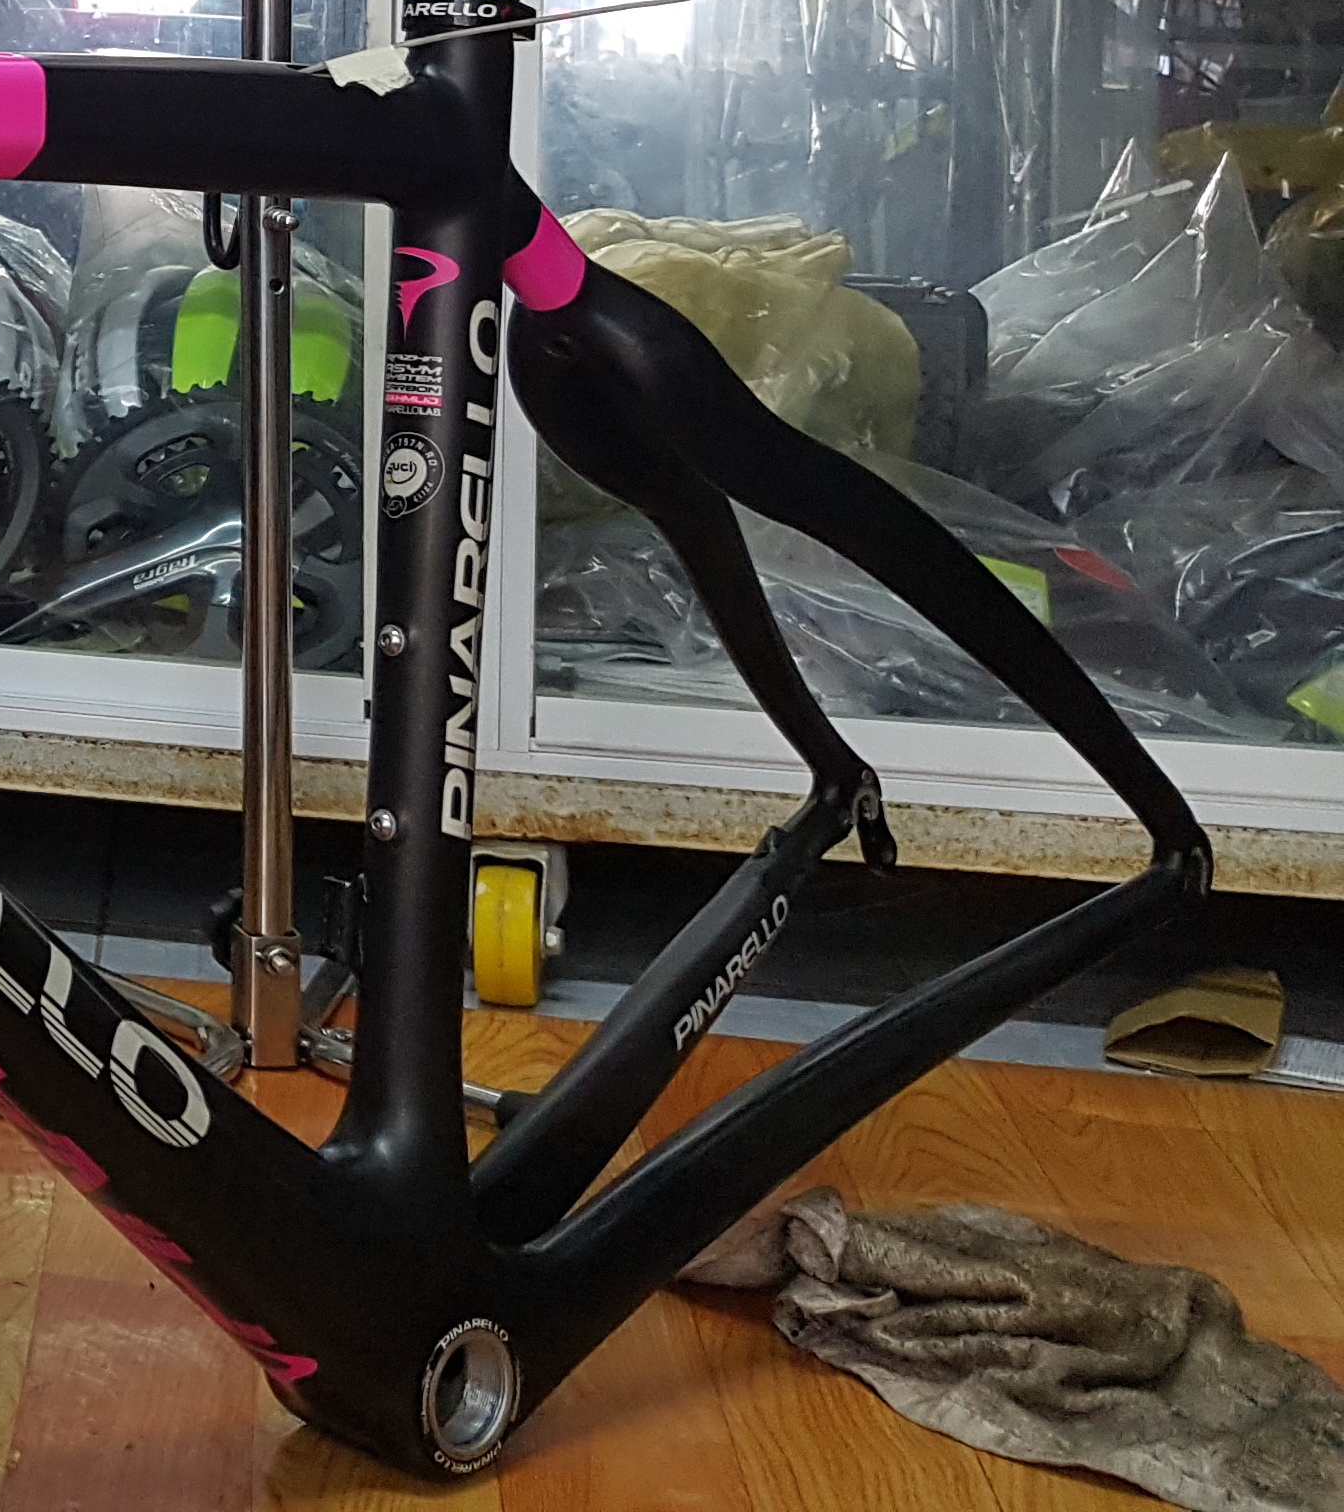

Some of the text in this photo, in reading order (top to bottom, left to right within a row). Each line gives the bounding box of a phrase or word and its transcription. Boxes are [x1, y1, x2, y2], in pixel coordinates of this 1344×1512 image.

[132, 554, 197, 586] Tiagra
[440, 299, 502, 842] PINARELLO
[672, 893, 790, 1052] PINARELLO
[439, 1317, 510, 1350] PINARELLO
